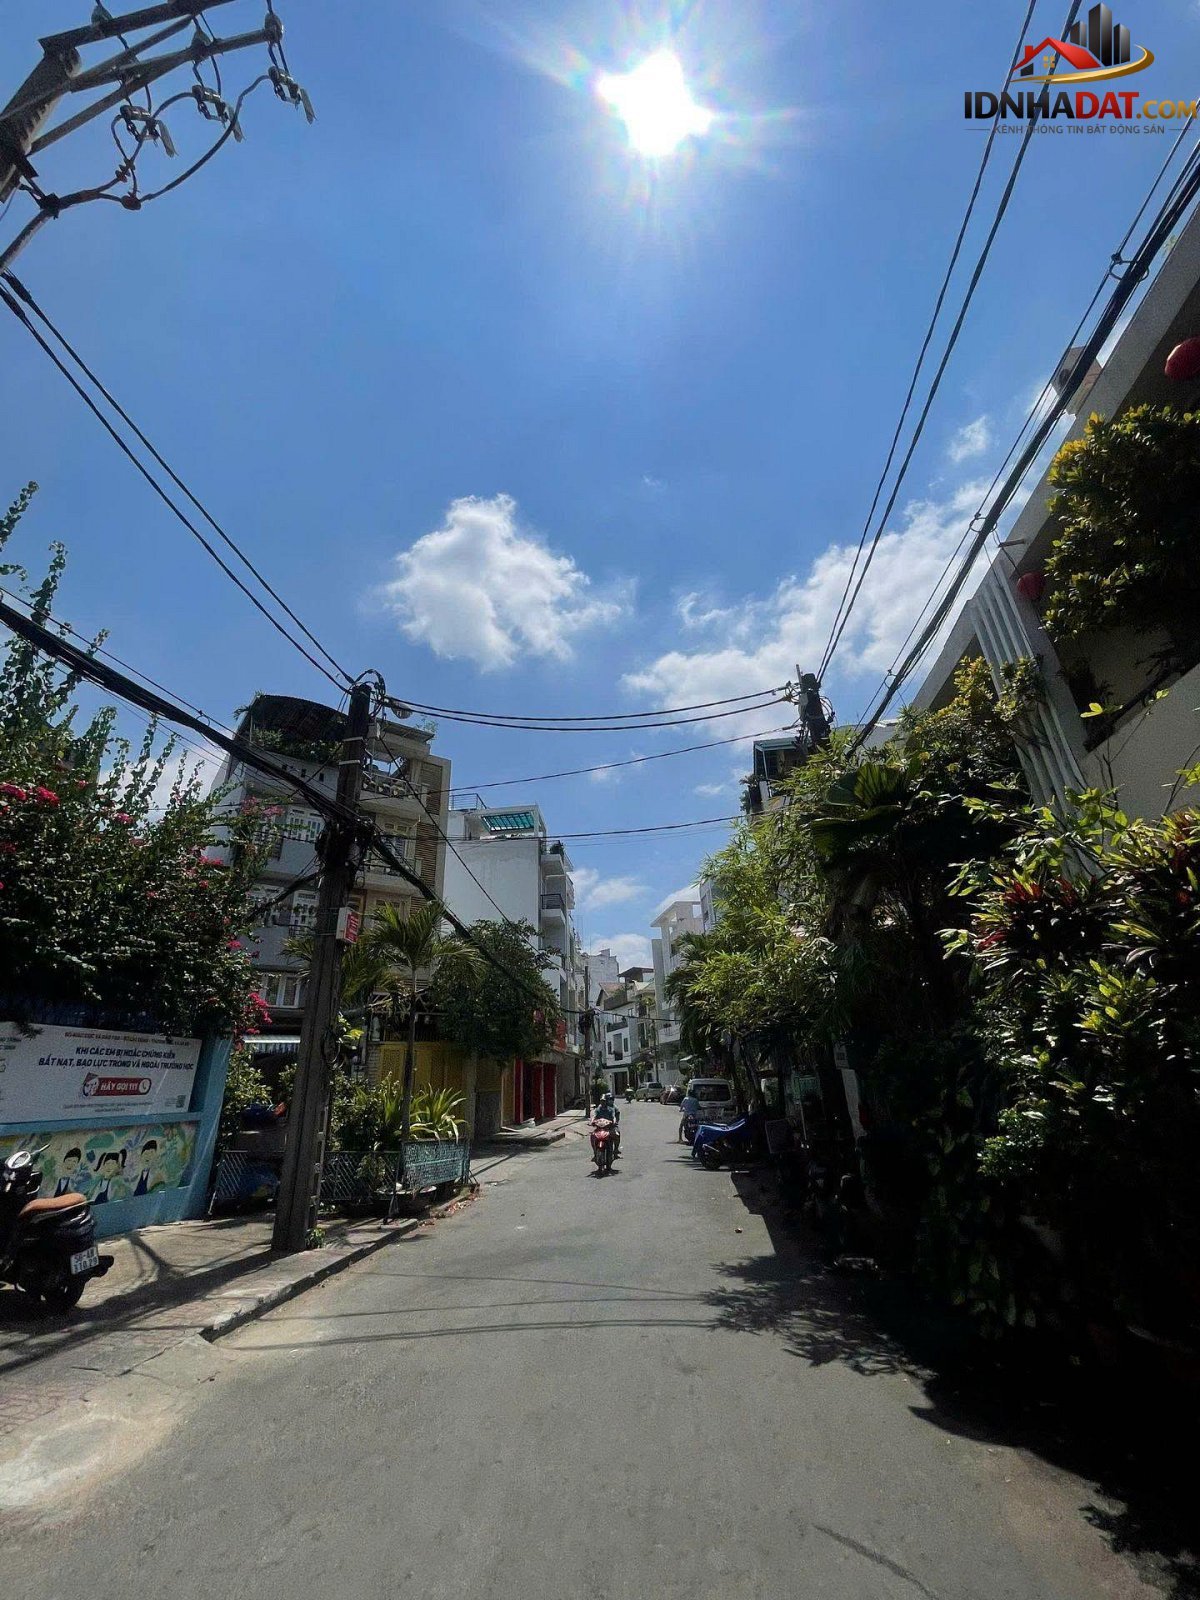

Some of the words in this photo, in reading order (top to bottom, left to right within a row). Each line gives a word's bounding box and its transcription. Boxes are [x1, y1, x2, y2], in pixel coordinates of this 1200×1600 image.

[75, 1047, 90, 1055] KHI
[89, 1046, 105, 1056] CÁC
[38, 1053, 57, 1066] BẤT
